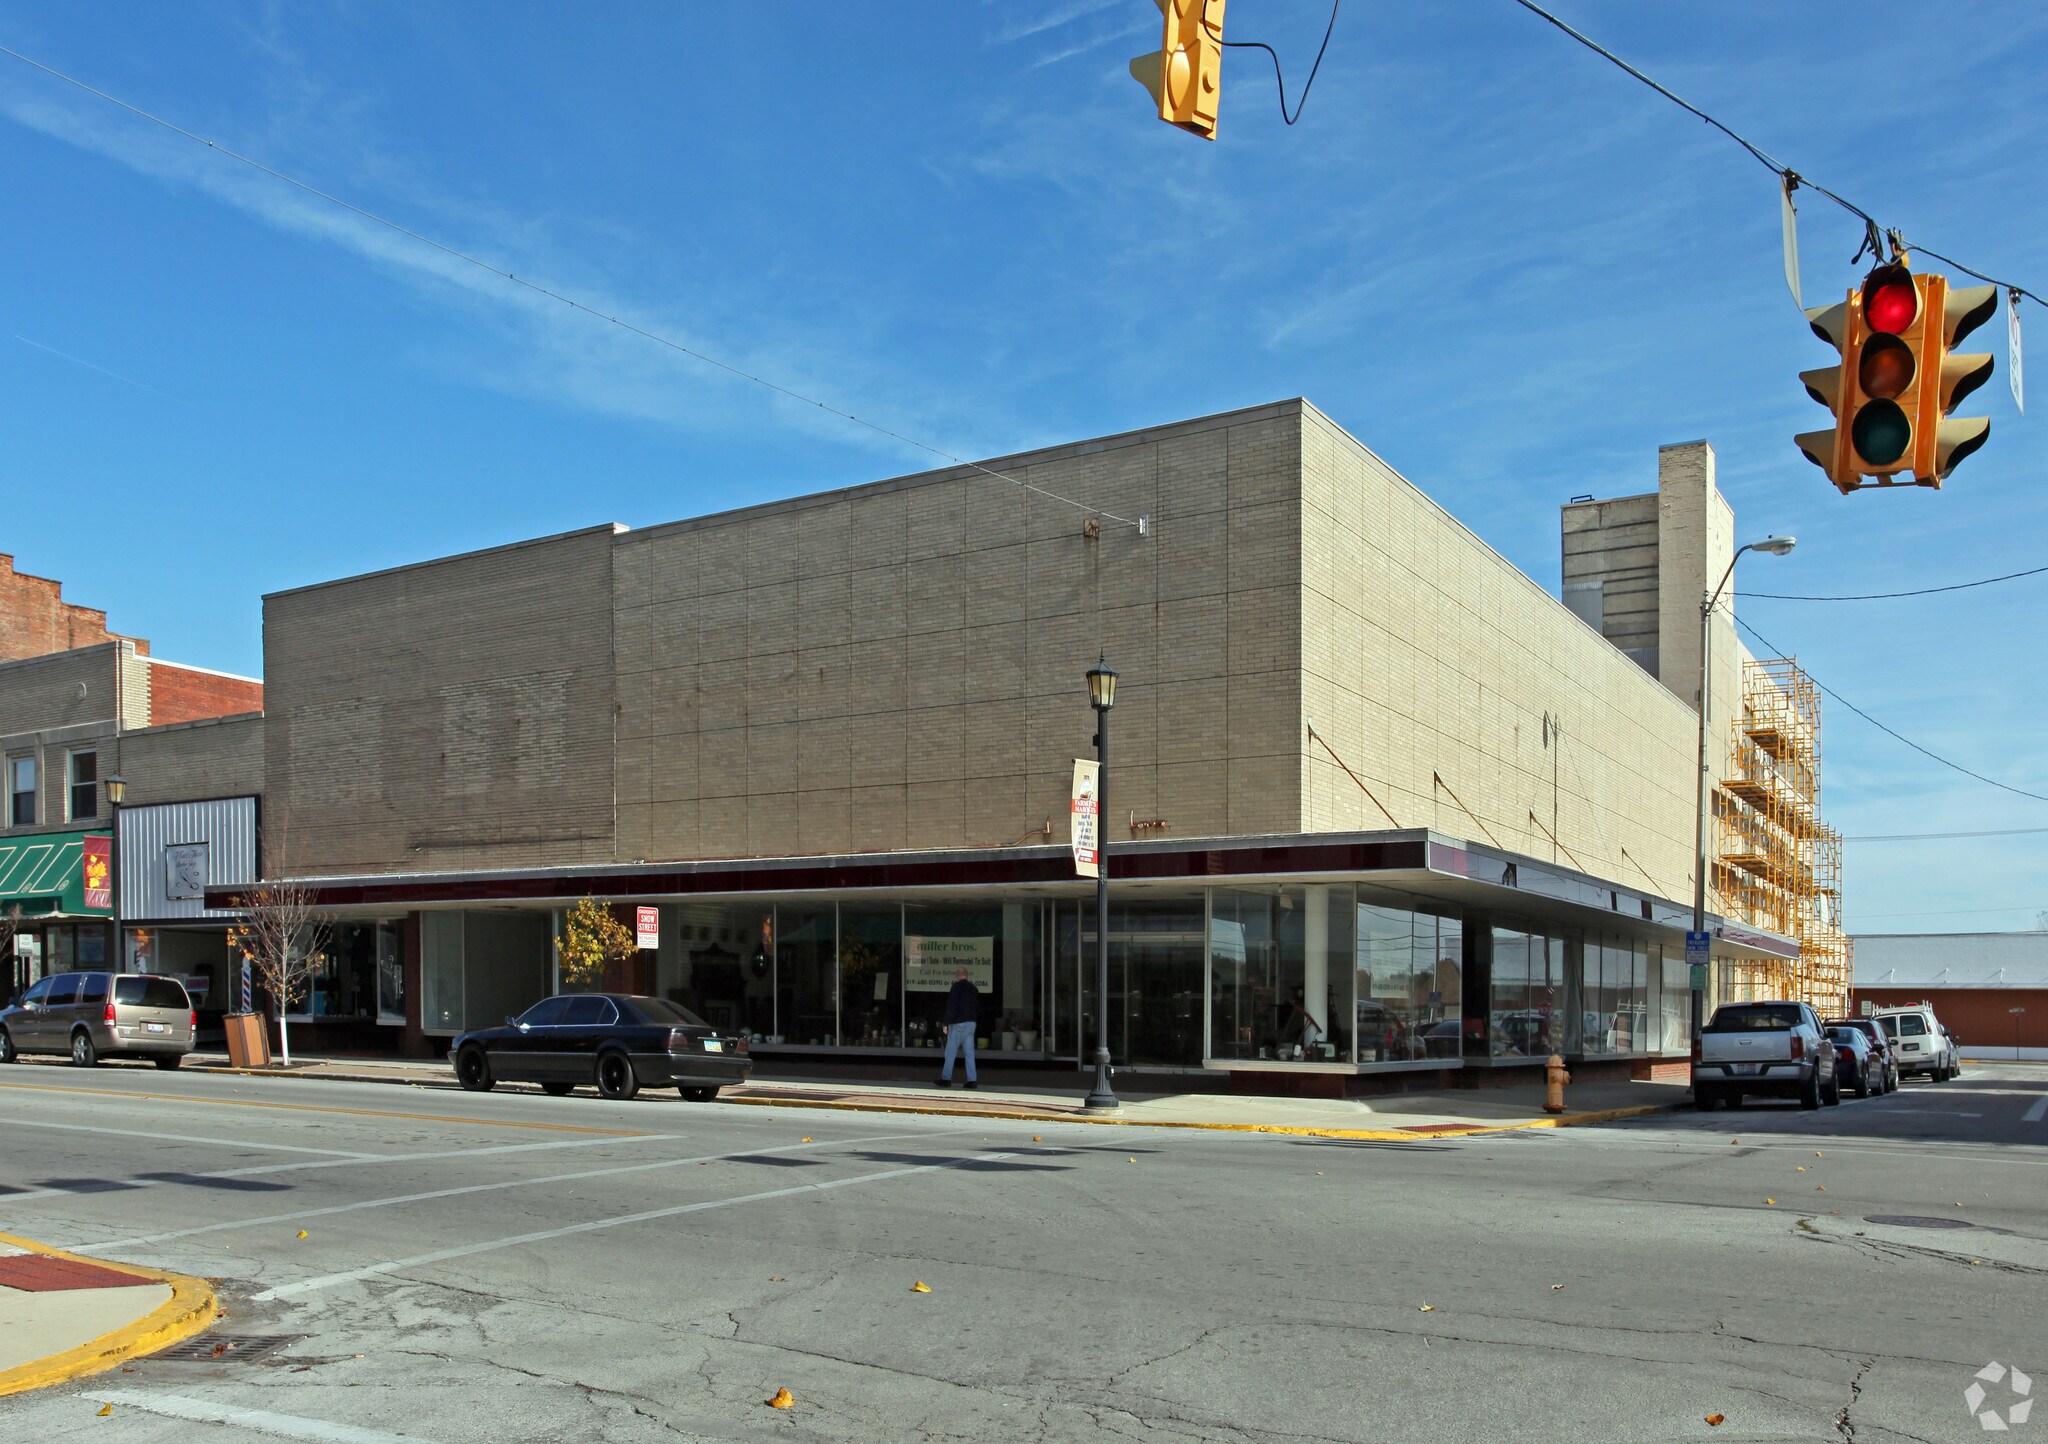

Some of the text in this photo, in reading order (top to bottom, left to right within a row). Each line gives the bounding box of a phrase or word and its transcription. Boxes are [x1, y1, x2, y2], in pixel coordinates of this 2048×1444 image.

[641, 915, 655, 923] SNOW
[638, 923, 657, 932] STREET
[917, 941, 977, 952] miller bros.
[929, 957, 940, 965] Sale
[943, 957, 952, 965] Will
[952, 957, 974, 966] Remodel
[974, 957, 981, 966] To
[981, 957, 992, 966] Suit
